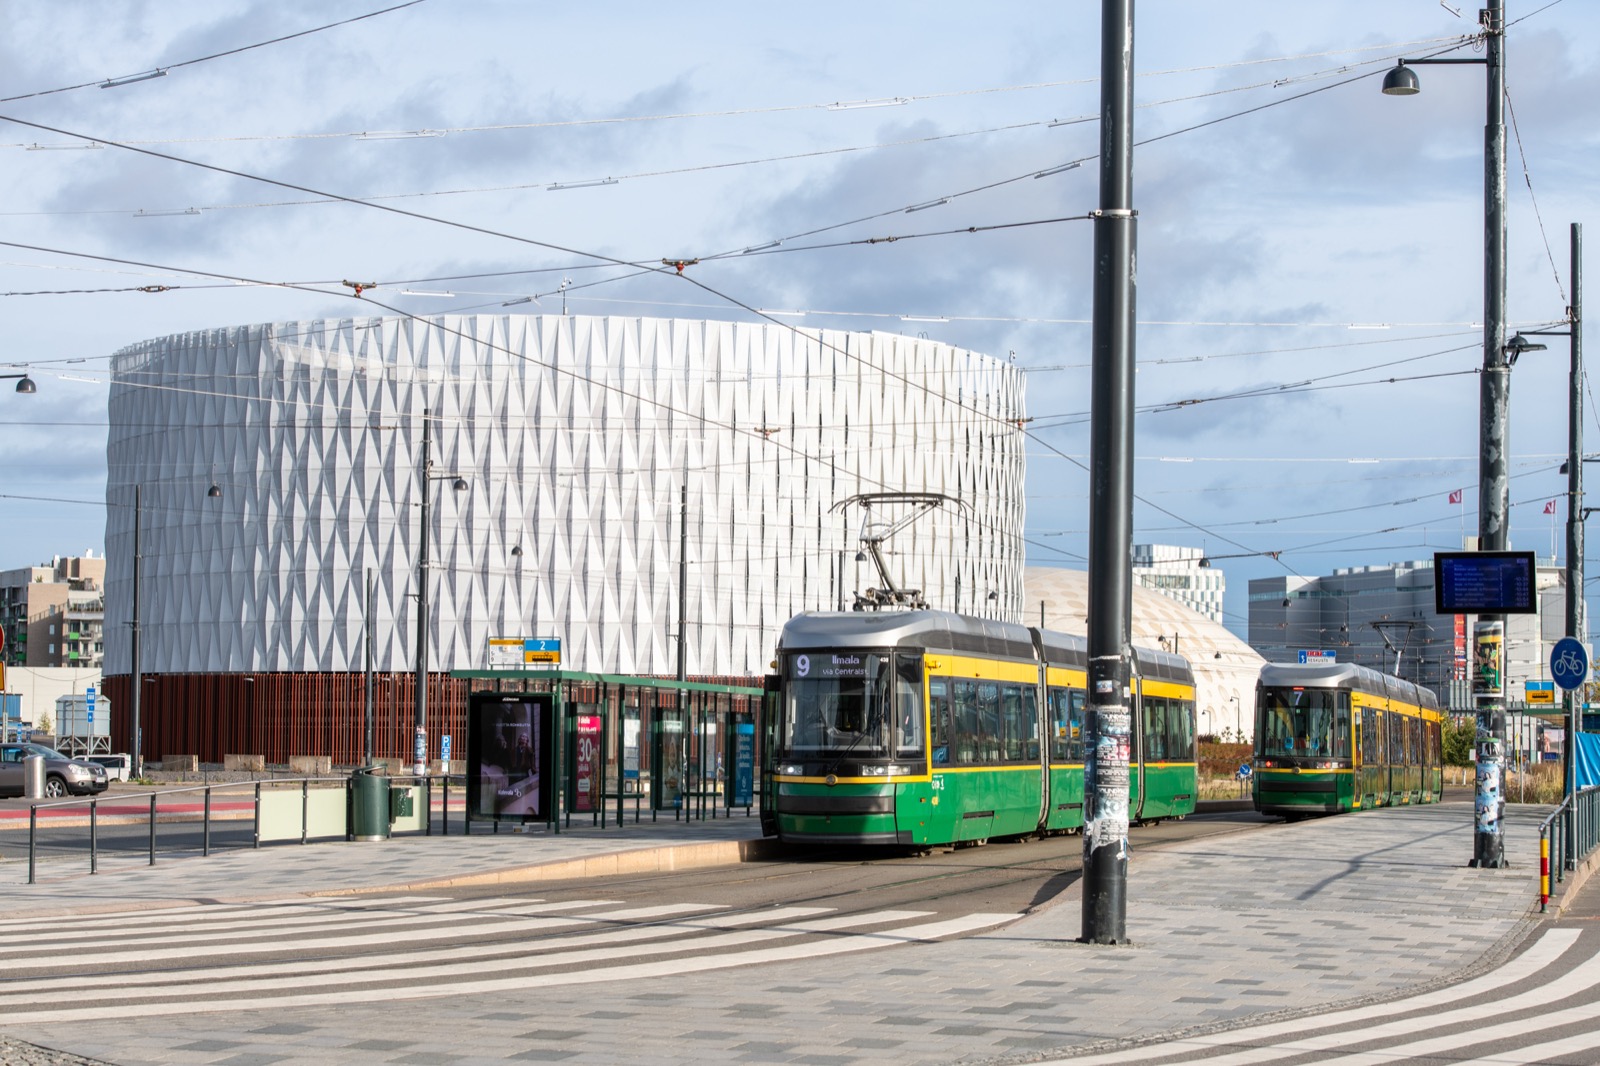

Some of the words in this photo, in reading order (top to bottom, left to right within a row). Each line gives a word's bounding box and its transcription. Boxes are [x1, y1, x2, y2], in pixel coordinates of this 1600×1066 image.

[540, 640, 546, 650] 2
[796, 654, 810, 677] 9
[832, 655, 859, 664] Ilmala
[1294, 691, 1303, 705] 7
[578, 738, 592, 762] 30
